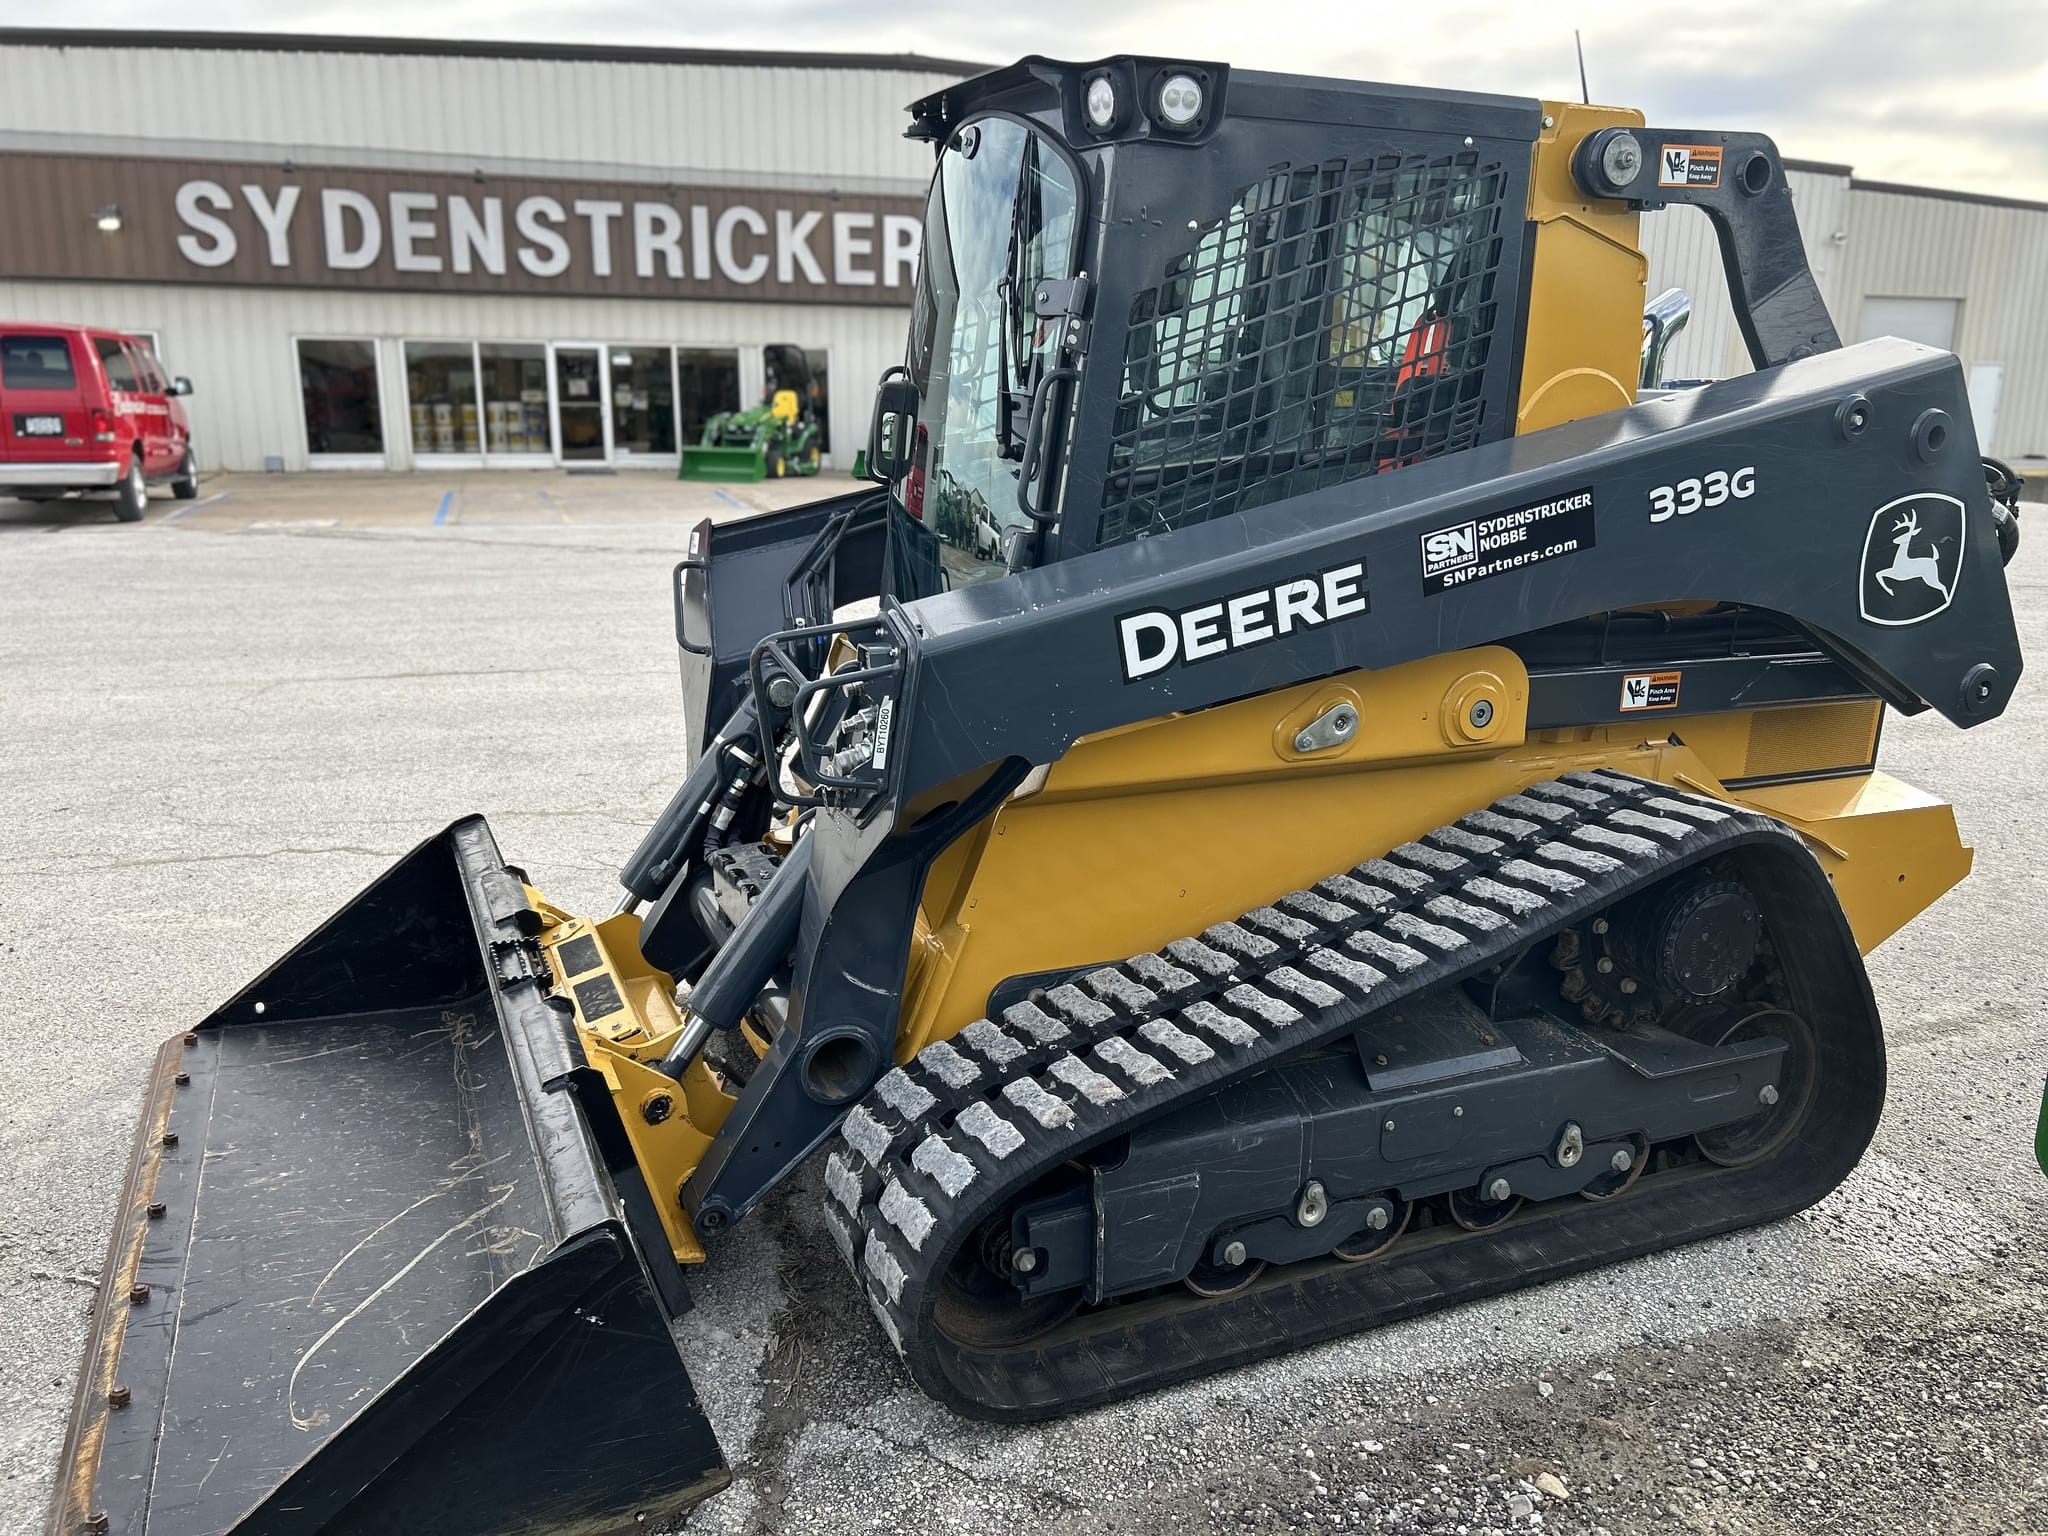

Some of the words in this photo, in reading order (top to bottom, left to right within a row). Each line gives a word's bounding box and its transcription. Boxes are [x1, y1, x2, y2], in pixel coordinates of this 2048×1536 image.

[1690, 164, 1705, 172] Pinch
[174, 180, 923, 288] SYDENSTRICKER
[1478, 493, 1592, 536] SYDENSTRICKER
[1649, 466, 1755, 522] 333G
[1426, 526, 1473, 562] SN
[1428, 552, 1475, 572] PARTNERS
[1480, 527, 1528, 553] NOBBE
[1443, 539, 1578, 587] SNPartners.com
[1121, 563, 1366, 678] DEERE
[876, 708, 890, 754] BYT10260
